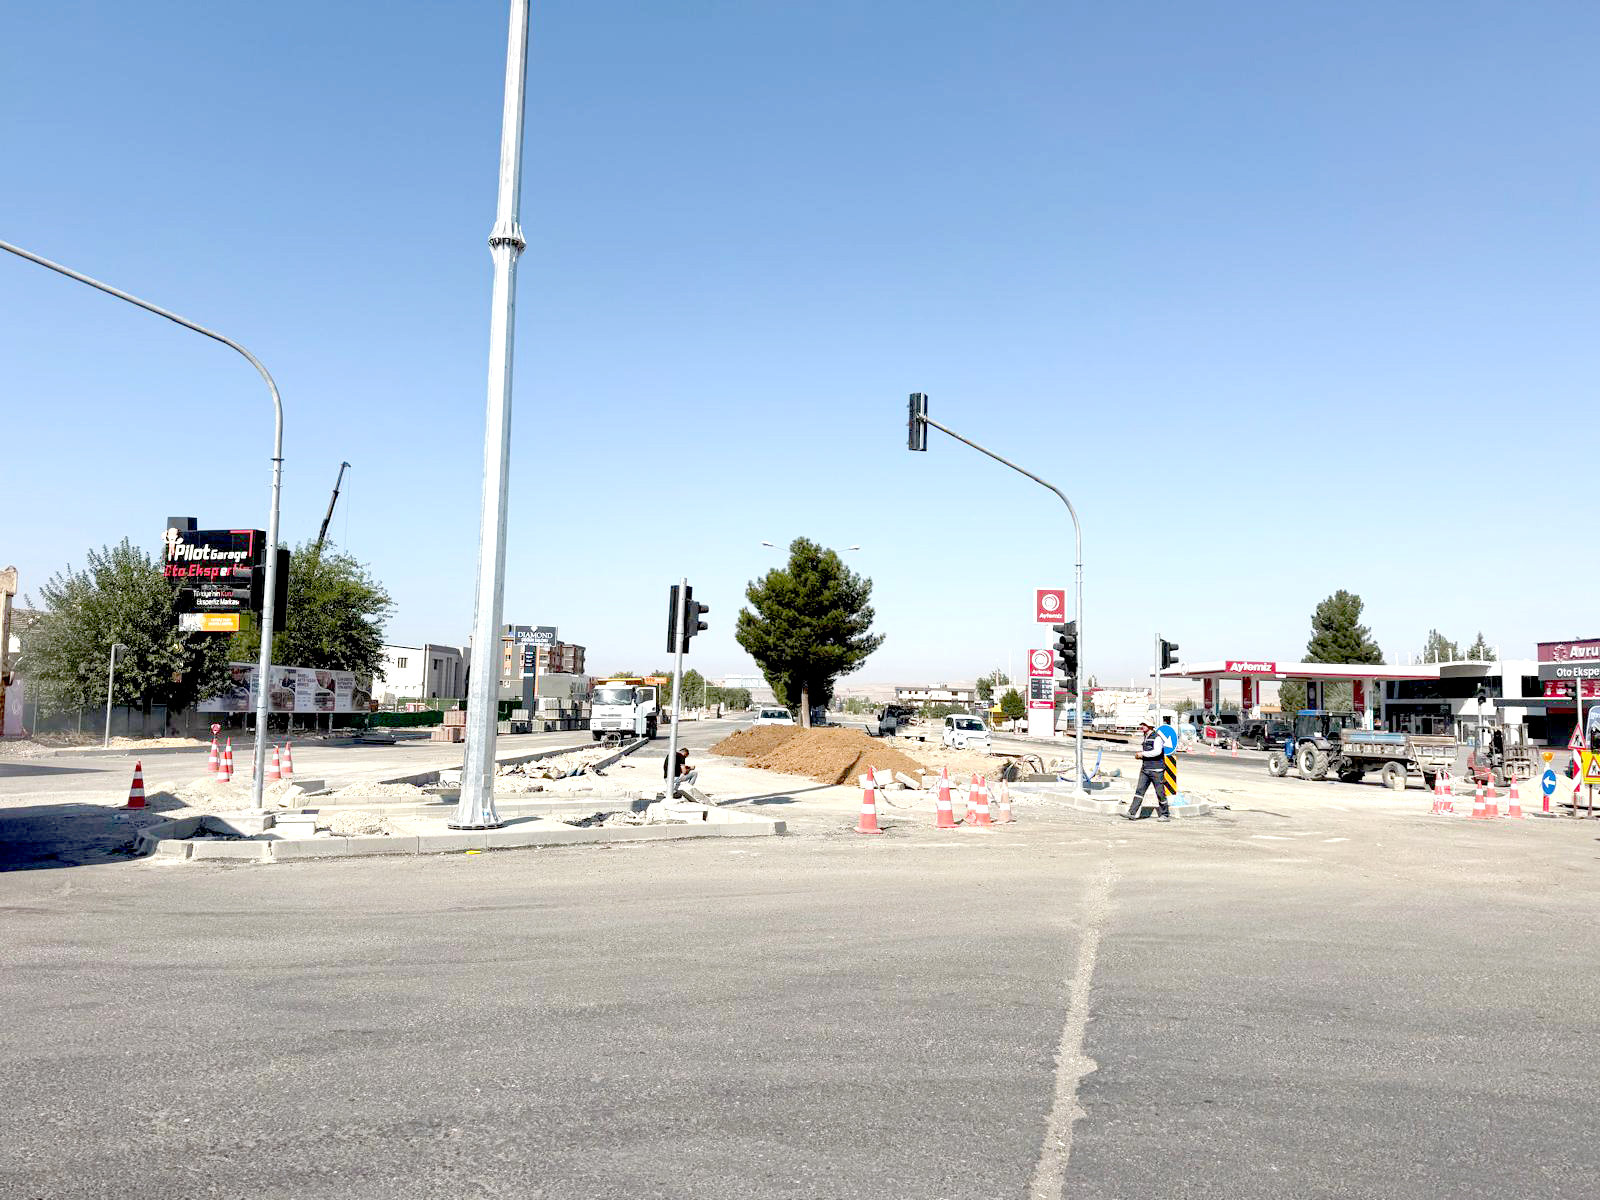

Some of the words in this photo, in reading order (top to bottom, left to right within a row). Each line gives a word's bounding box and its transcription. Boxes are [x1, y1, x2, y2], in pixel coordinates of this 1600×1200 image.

[174, 544, 210, 561] Pilot
[210, 549, 248, 562] Garage
[1231, 662, 1272, 672] Aytemiz
[1557, 667, 1572, 677] Oto
[1573, 666, 1600, 678] Ekspe
